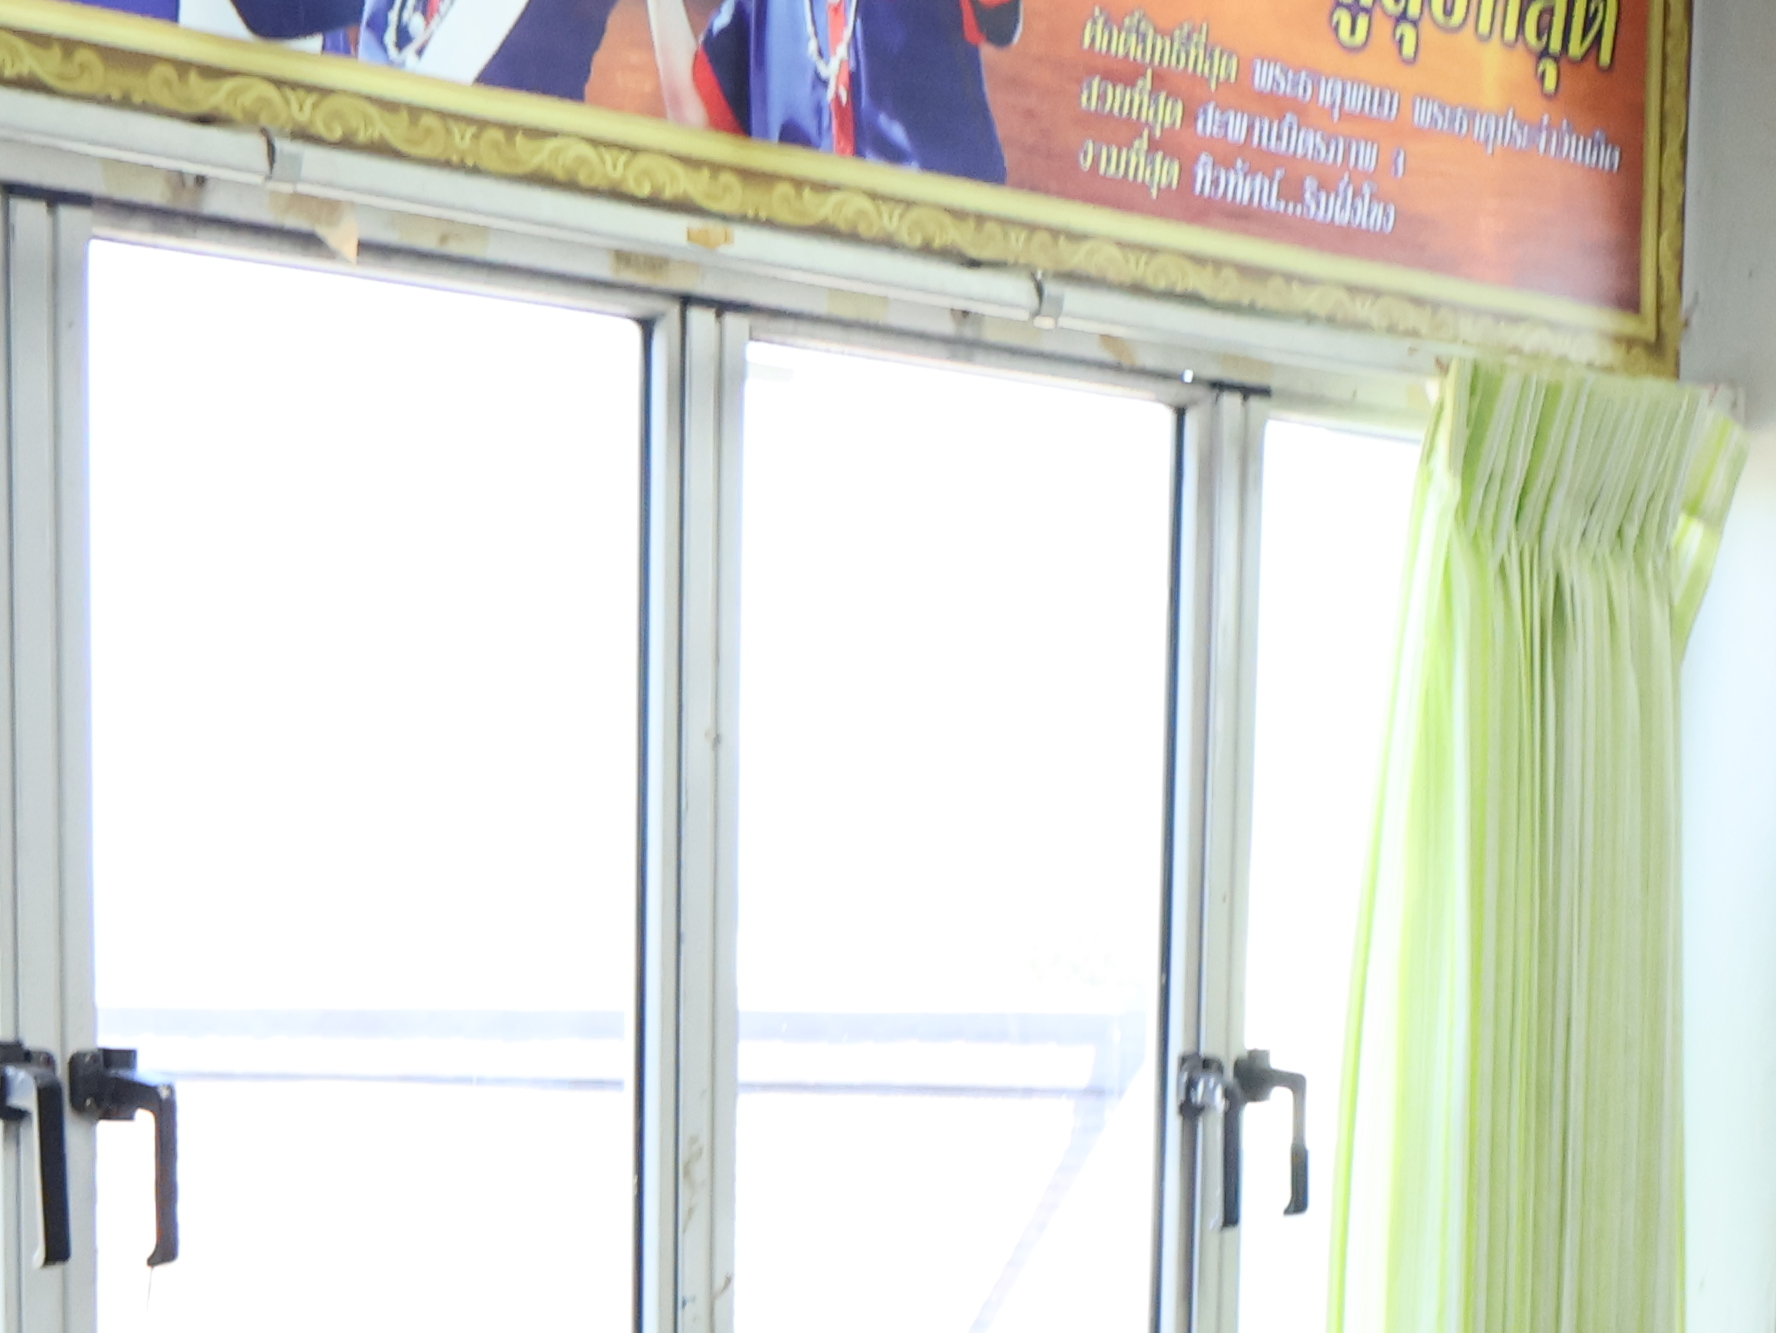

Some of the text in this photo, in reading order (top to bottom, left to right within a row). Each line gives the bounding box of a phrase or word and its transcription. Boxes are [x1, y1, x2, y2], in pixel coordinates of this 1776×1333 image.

[1079, 67, 1185, 140] สวยที่สุด
[1078, 127, 1182, 200] งามที่สุด
